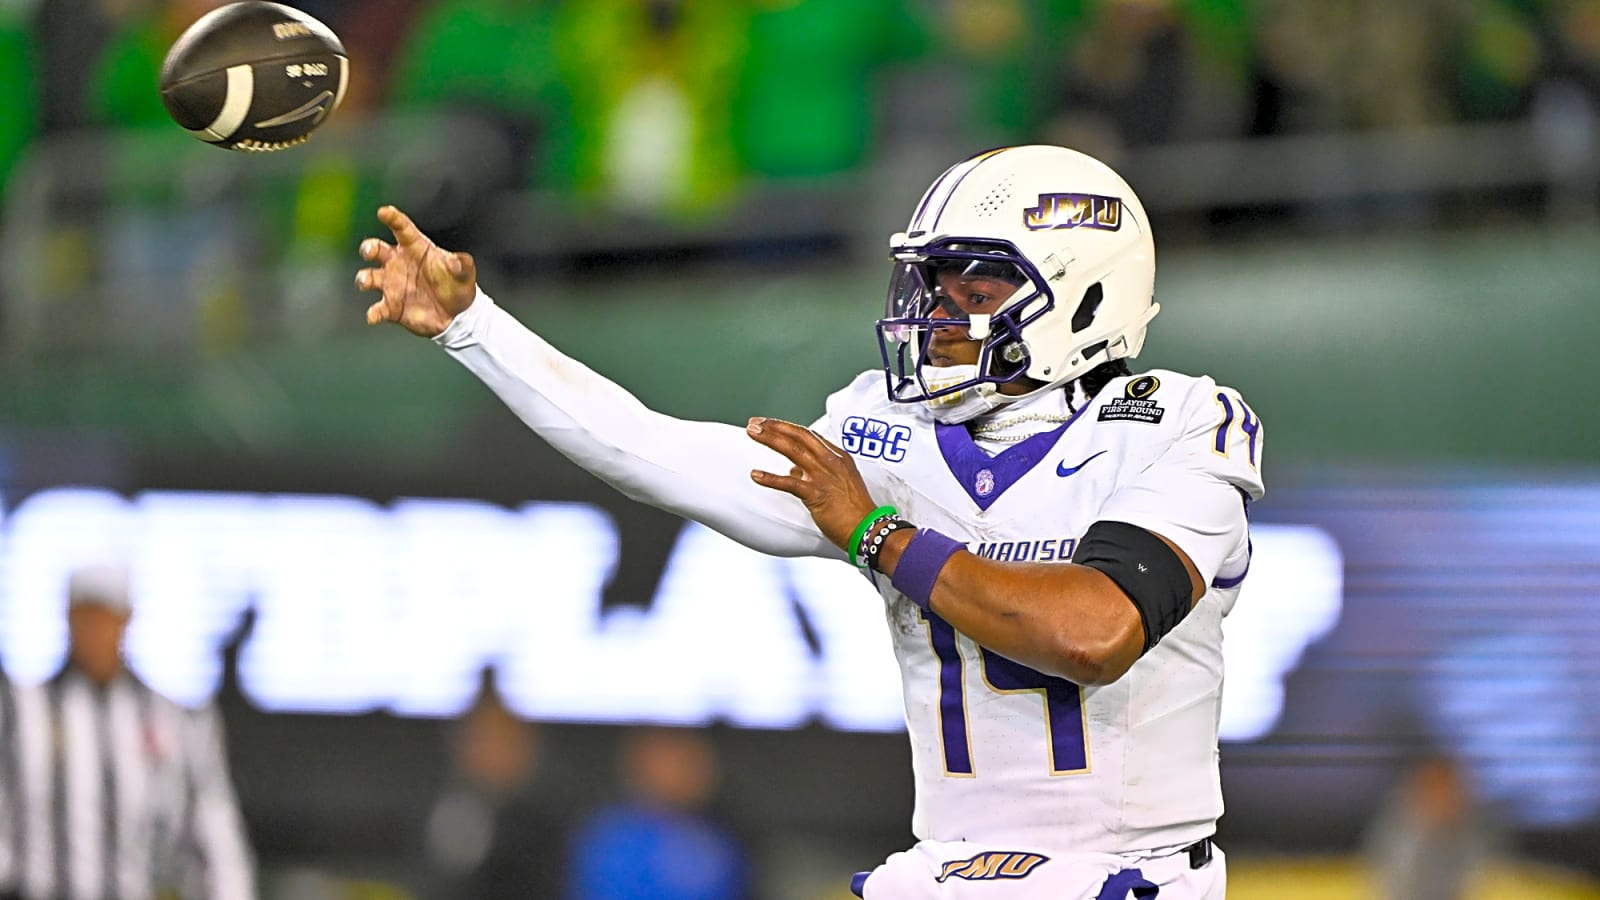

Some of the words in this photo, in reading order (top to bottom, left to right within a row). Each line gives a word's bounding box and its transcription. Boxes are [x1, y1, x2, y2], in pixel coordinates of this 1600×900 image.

[1024, 193, 1121, 231] JMU
[1101, 405, 1129, 414] FIRST
[1129, 406, 1162, 416] ROUND
[1113, 399, 1155, 408] PLAYOFF
[841, 415, 912, 463] SBC
[1212, 391, 1262, 475] 14
[976, 538, 1077, 561] MADISO
[917, 606, 1092, 778] 14
